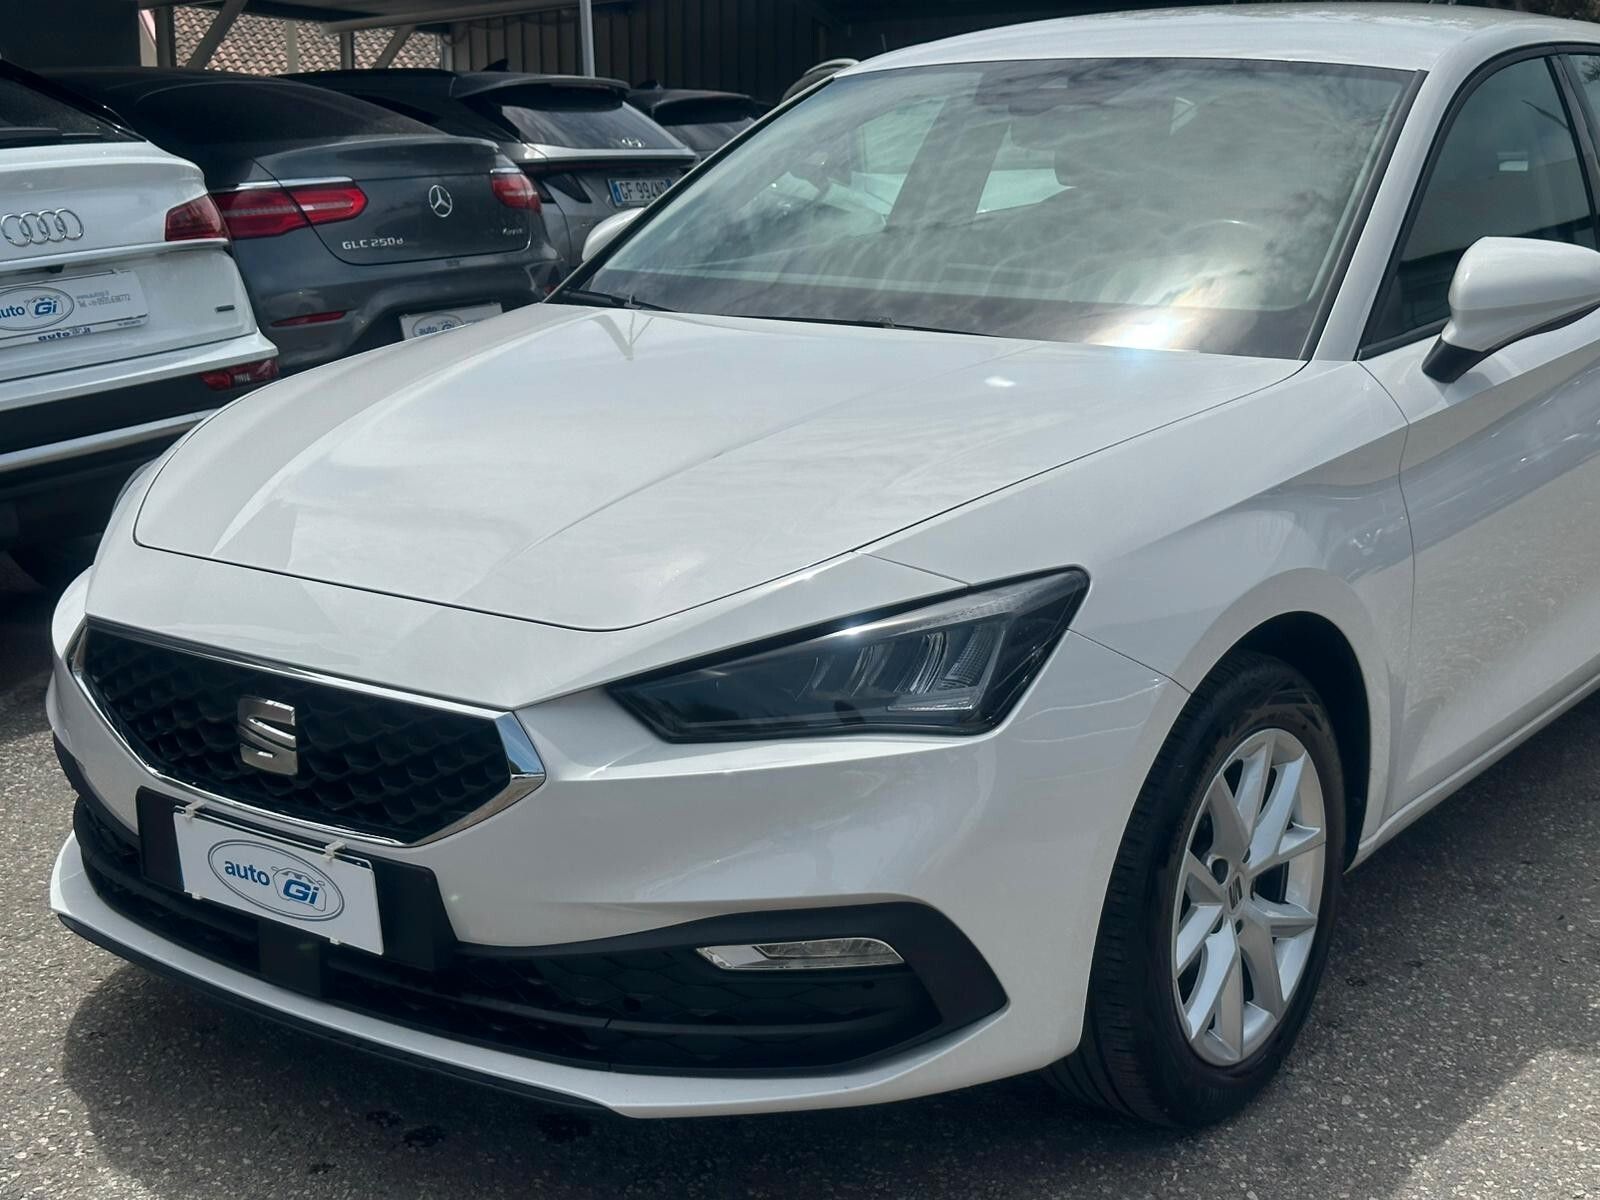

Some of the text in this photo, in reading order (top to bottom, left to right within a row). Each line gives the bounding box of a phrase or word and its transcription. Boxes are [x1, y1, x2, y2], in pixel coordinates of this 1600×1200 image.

[620, 182, 633, 200] GF
[342, 239, 369, 250] GLC
[0, 301, 57, 318] uto Gi
[224, 860, 320, 905] auto Gi
